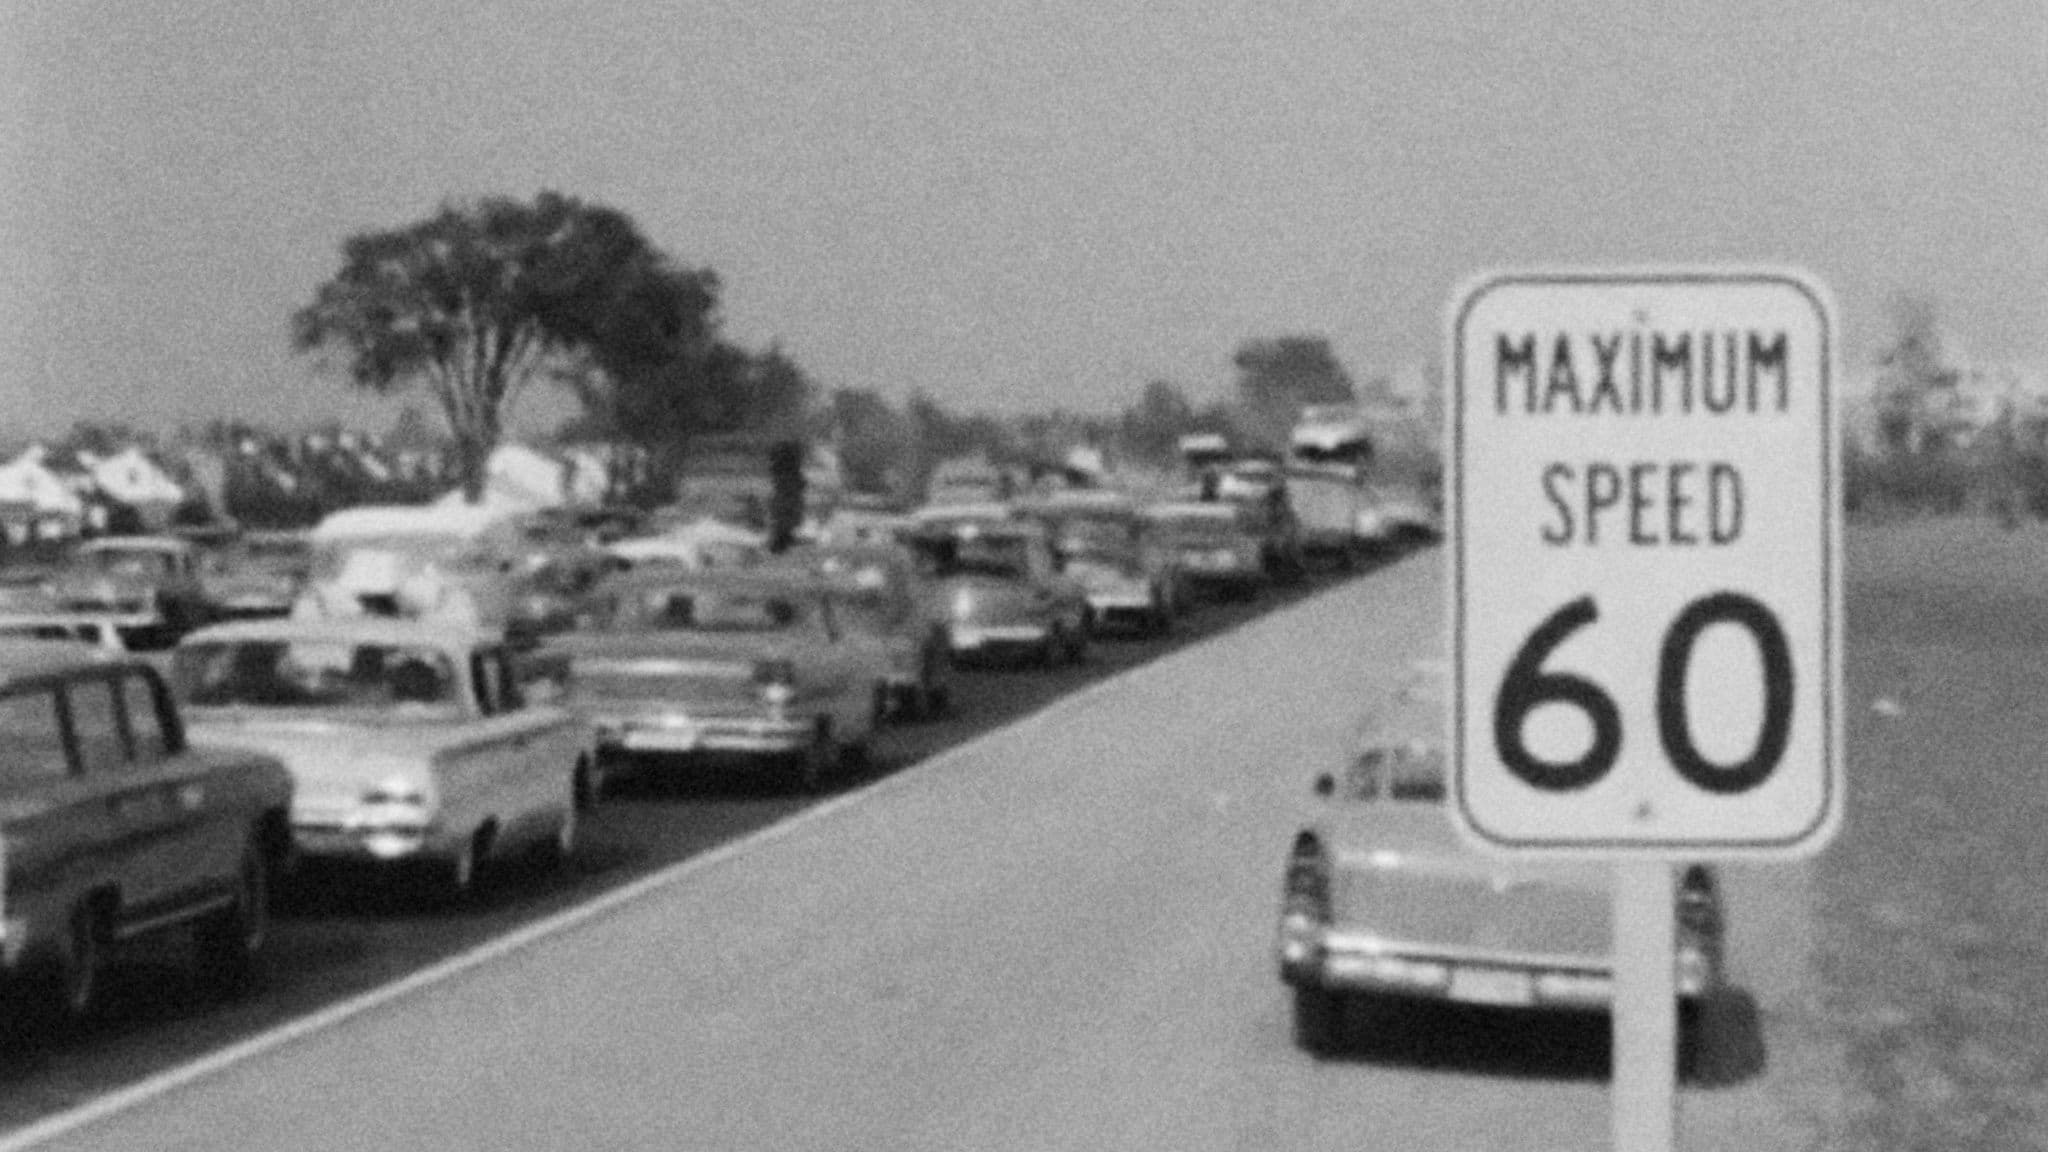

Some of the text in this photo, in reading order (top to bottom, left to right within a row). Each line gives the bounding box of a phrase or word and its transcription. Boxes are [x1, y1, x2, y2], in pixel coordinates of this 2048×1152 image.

[1495, 332, 1789, 415] MAXIMUM
[1541, 462, 1744, 545] SPEED
[1493, 591, 1795, 795] 60
